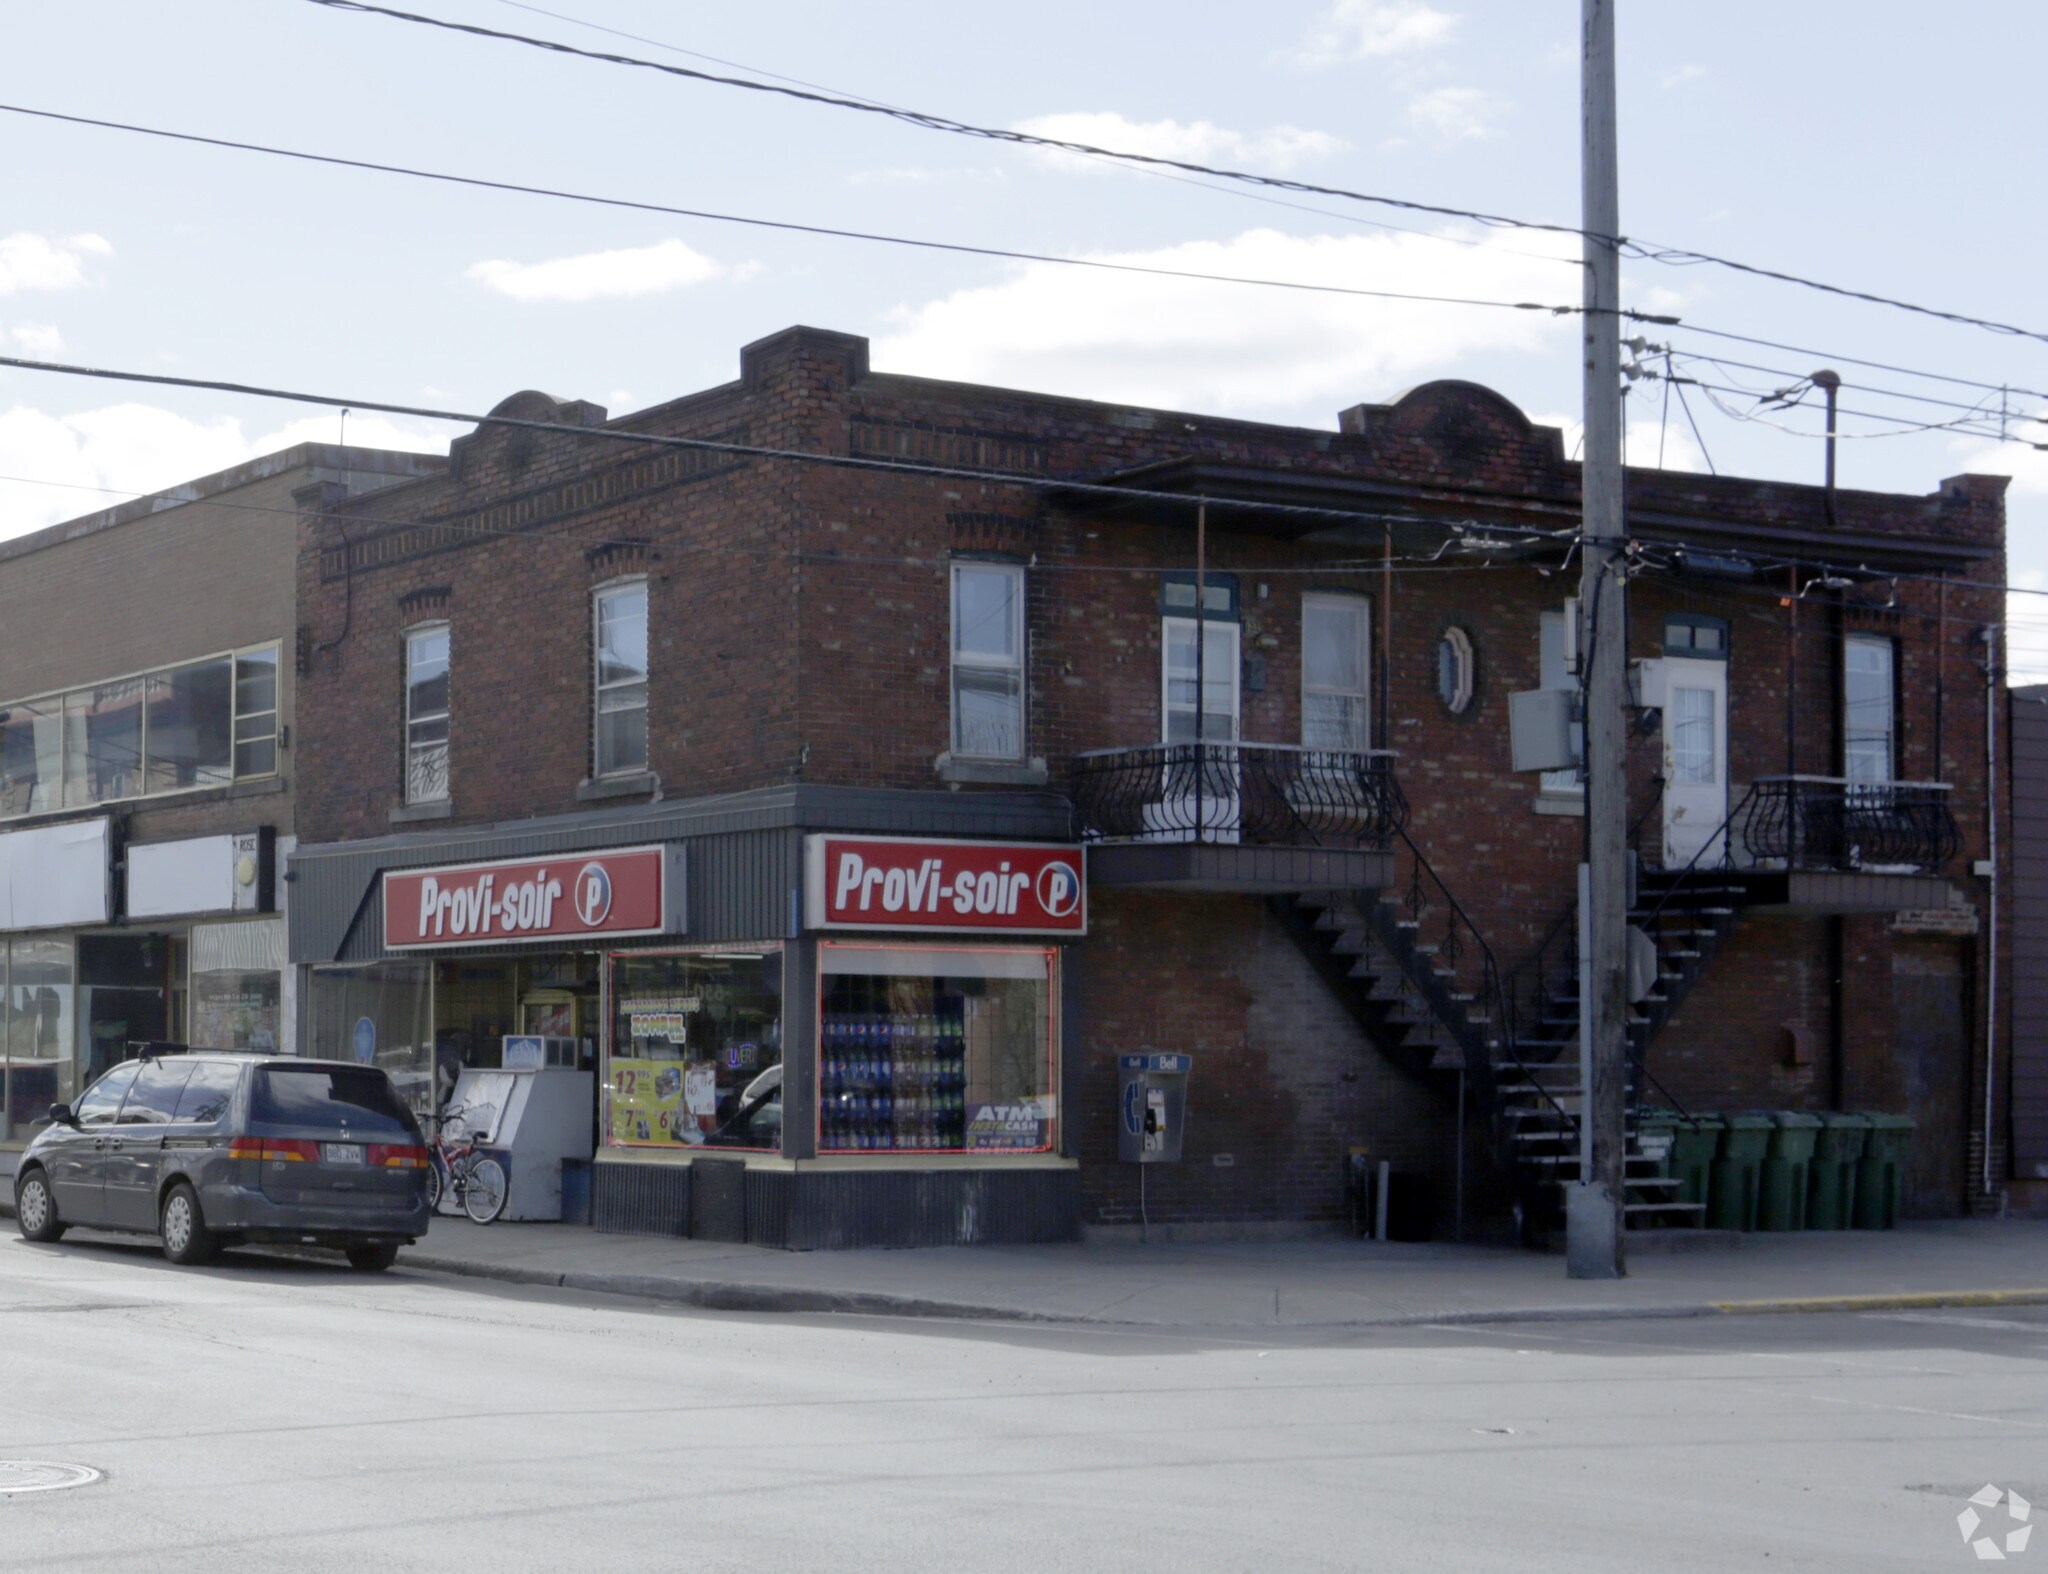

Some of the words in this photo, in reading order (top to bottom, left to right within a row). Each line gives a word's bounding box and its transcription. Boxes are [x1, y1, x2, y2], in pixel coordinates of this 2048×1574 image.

[240, 838, 255, 852] ROSE
[1129, 1057, 1140, 1067] Bell
[1160, 1056, 1177, 1069] Bell
[615, 1070, 636, 1094] 12
[974, 1105, 1033, 1121] ATM
